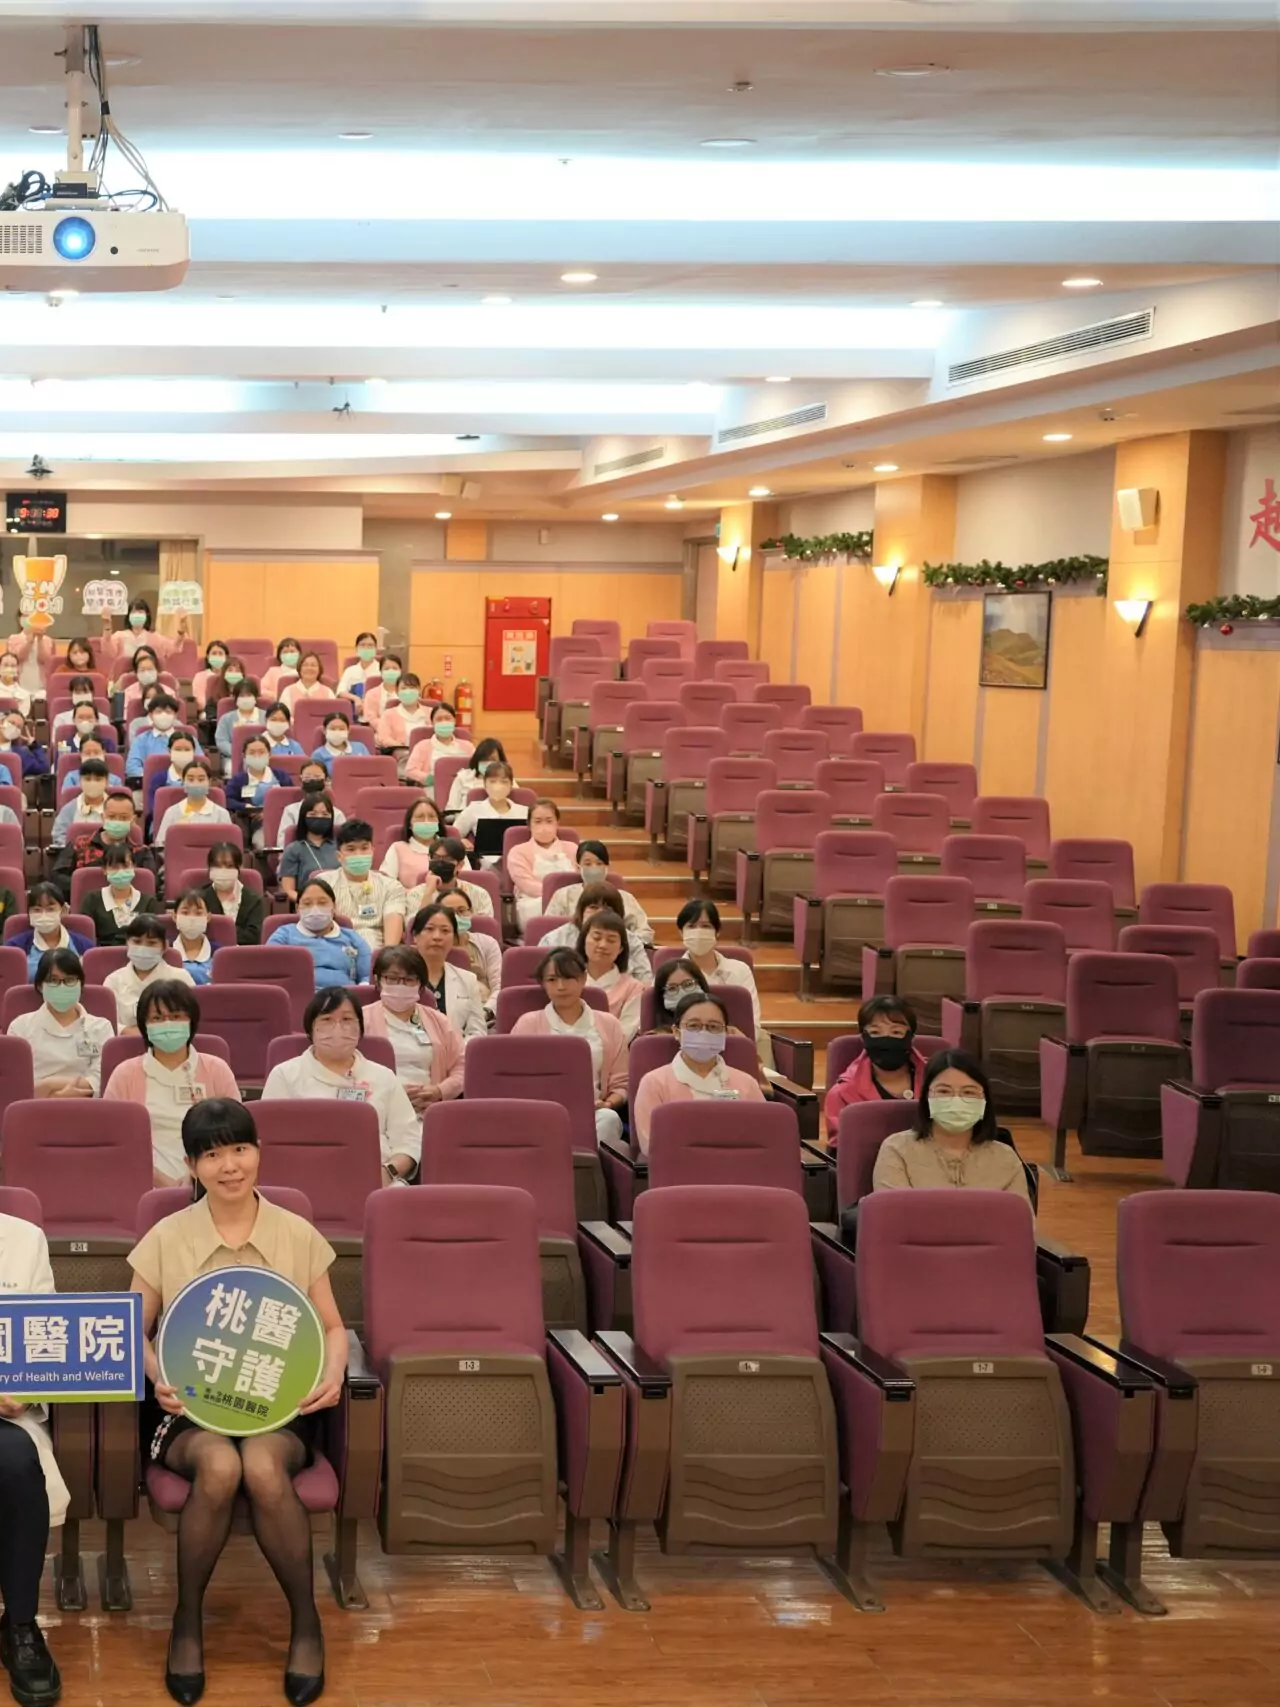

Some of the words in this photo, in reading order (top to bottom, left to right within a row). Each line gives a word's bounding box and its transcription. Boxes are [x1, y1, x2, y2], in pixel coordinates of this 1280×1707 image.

[205, 1282, 302, 1350] 桃醫
[12, 1371, 23, 1382] of
[26, 1371, 60, 1382] Health
[62, 1371, 82, 1382] and
[85, 1370, 125, 1382] Welfare
[192, 1337, 286, 1402] 守護
